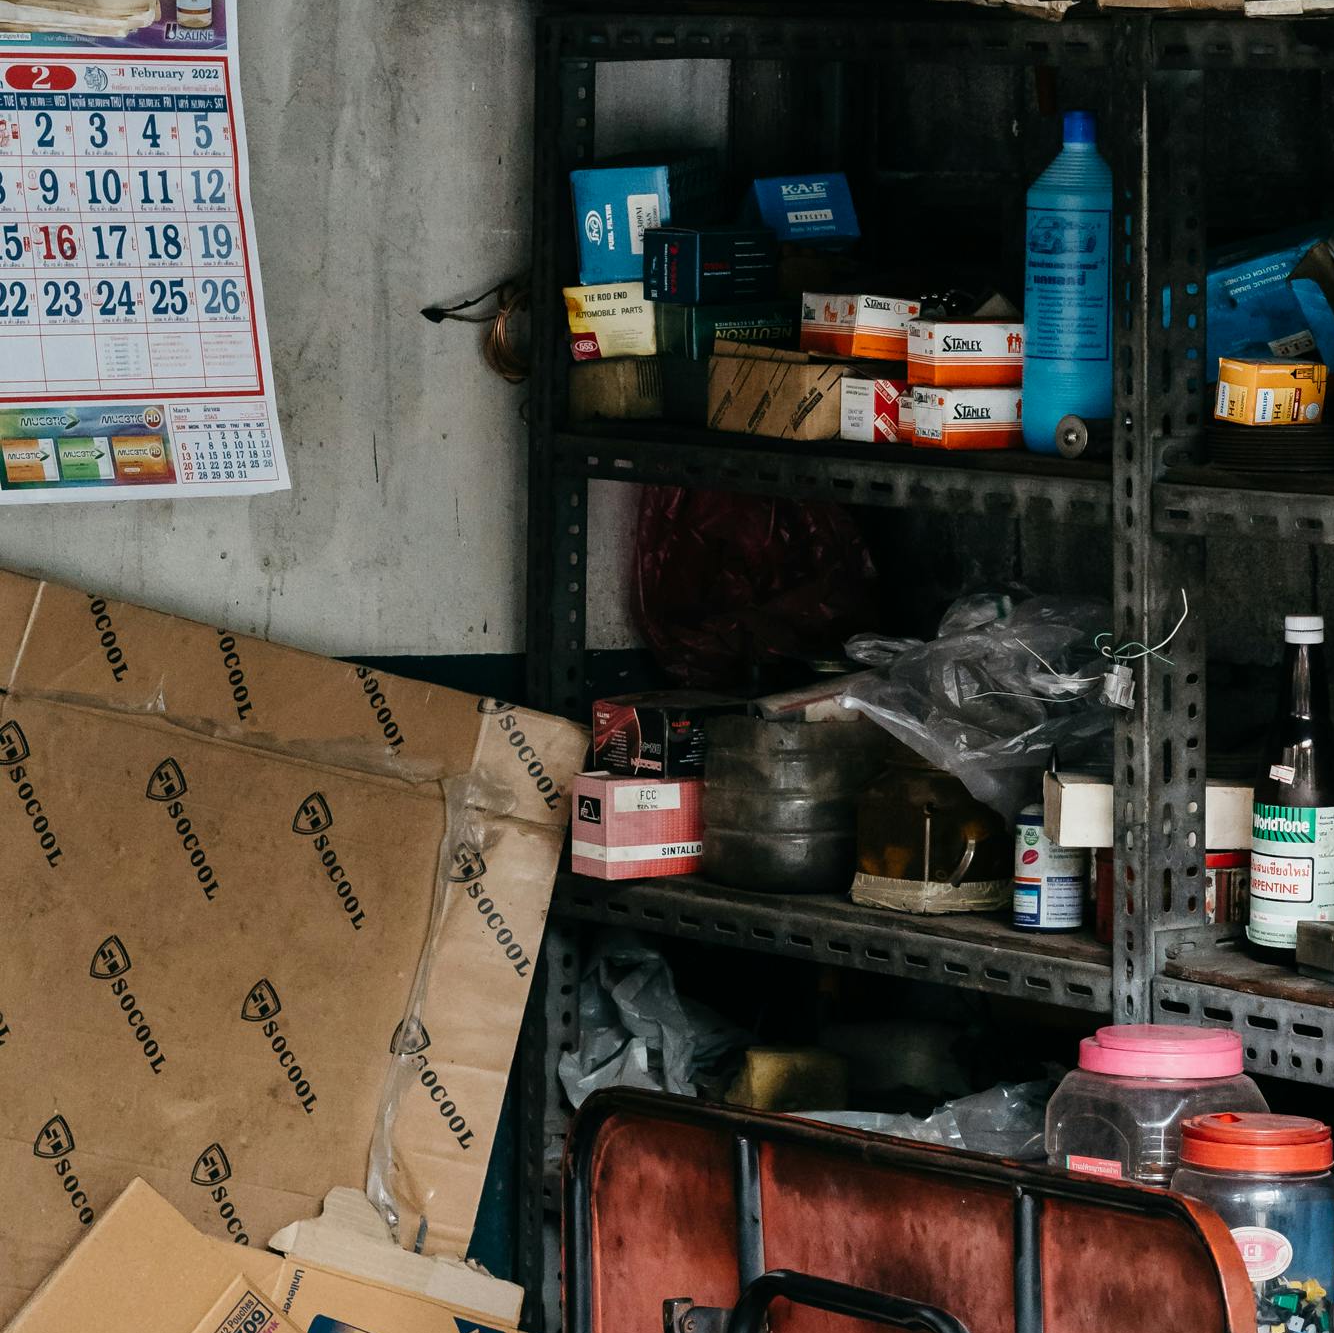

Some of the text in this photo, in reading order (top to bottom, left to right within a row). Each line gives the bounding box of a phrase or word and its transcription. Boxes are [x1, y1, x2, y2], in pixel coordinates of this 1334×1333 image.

[31, 65, 51, 89] 2
[130, 67, 220, 81] February 2022
[54, 95, 225, 109] WED THU FRI SAT
[35, 111, 213, 149] 2 3 4 5
[39, 169, 226, 205] 9 10 11 12
[39, 224, 233, 261] 16 17 18 19
[604, 203, 615, 251] FUEL FILTER
[43, 278, 241, 318] 23 24 25 26
[575, 305, 643, 319] AUTOMOBILE PARTS
[583, 291, 628, 303] TIE ROD END
[578, 341, 595, 351] 555
[714, 326, 793, 341] NEUTRON
[1228, 399, 1236, 417] H4
[1261, 390, 1269, 421] PHILIPS
[1273, 402, 1283, 420] H4
[355, 666, 407, 757] SOCOOL
[499, 713, 559, 812] SOCOOL
[639, 789, 657, 801] FCC
[11, 767, 67, 869] SOCOOL
[1252, 814, 1310, 834] WorldTone
[166, 800, 223, 902] SOCOOL
[312, 835, 365, 932] SOCOOL
[466, 879, 532, 979] SOCOOL
[112, 978, 166, 1075] SOCOOL
[262, 1019, 321, 1117] SOCOOL
[282, 1268, 305, 1316] Unilever
[227, 1298, 255, 1330] Pouches
